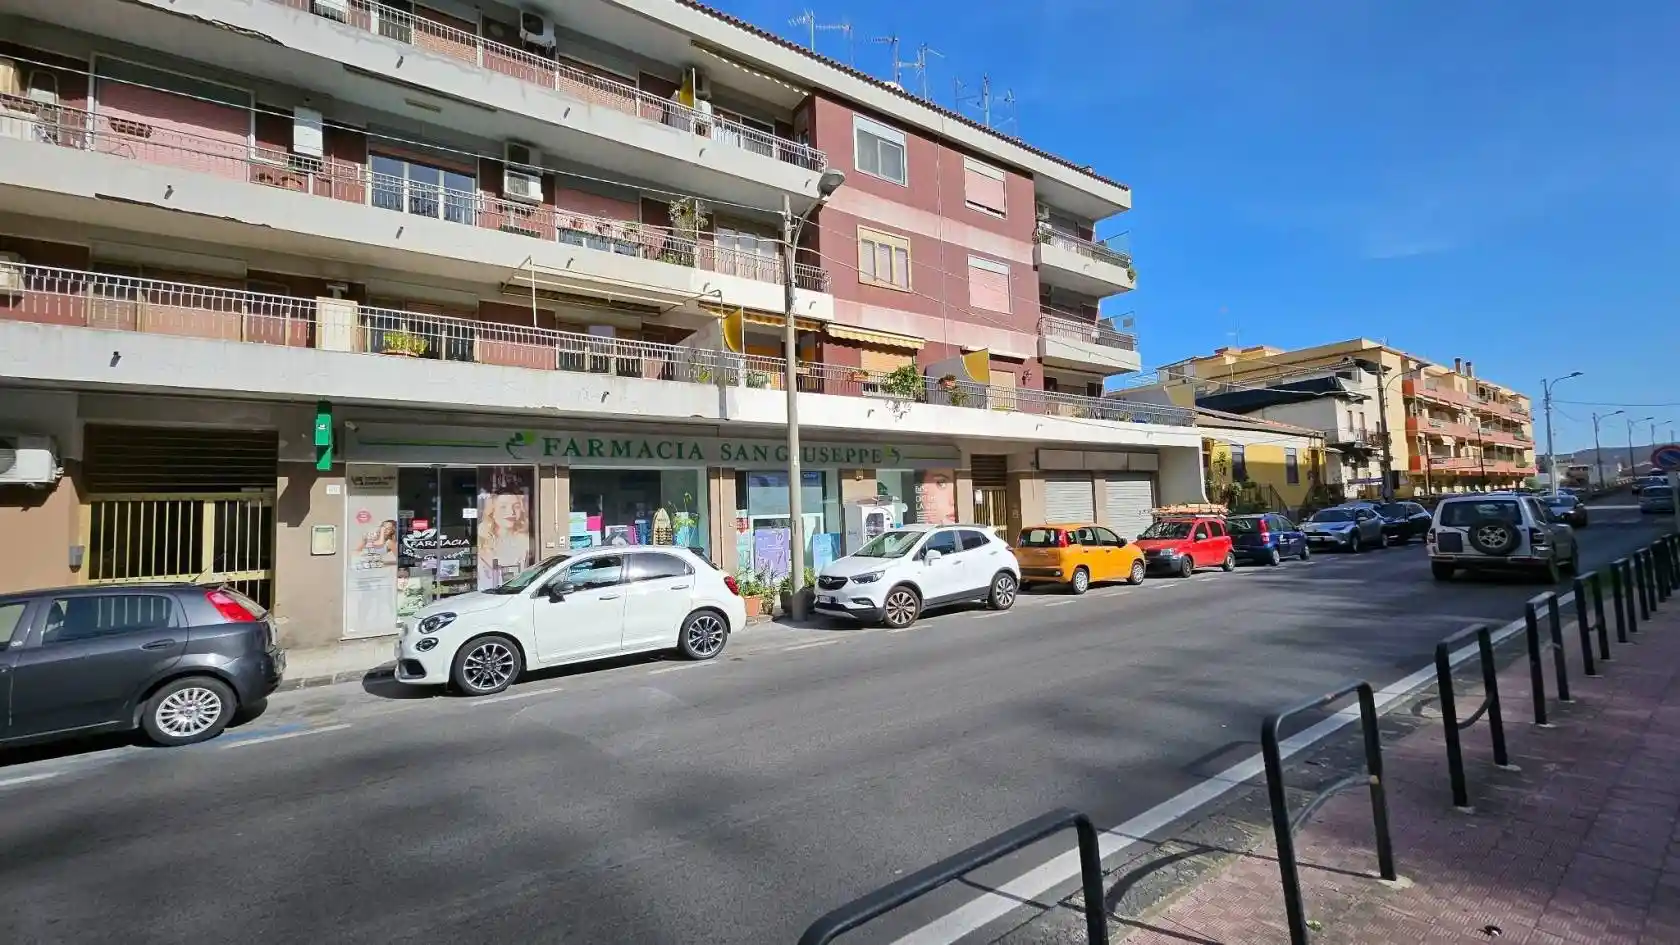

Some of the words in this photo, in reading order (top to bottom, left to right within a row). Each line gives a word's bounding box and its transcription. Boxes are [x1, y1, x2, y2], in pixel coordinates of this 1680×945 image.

[542, 437, 705, 460] FARMACIA
[720, 443, 769, 462] SAN
[775, 445, 883, 464] GUSEPPE
[410, 539, 470, 548] FARMACIA
